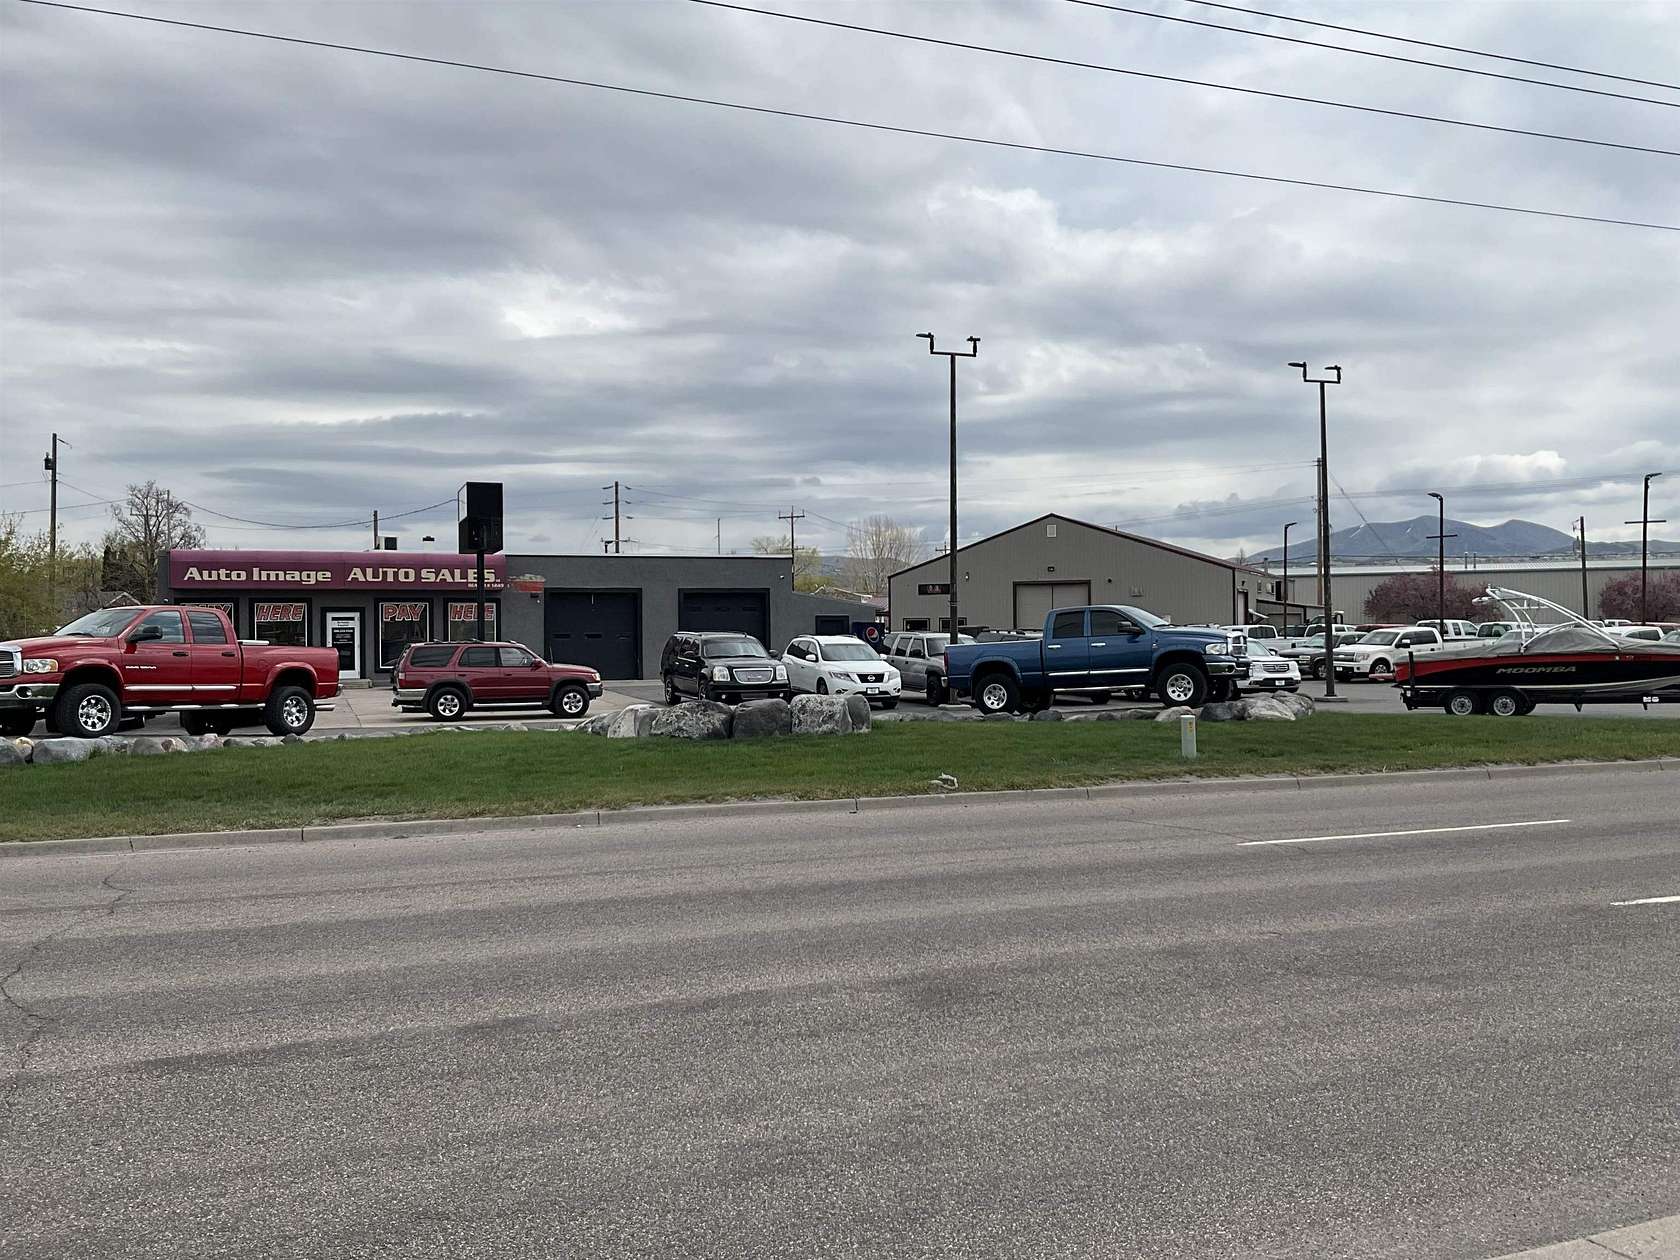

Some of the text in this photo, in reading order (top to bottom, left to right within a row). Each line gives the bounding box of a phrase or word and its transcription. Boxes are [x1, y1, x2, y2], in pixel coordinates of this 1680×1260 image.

[184, 567, 496, 585] Auto Image AUTO SALES
[256, 603, 305, 621] HERE
[383, 603, 425, 621] PAY
[450, 603, 496, 621] HEE
[1496, 666, 1576, 674] MOOMBA
